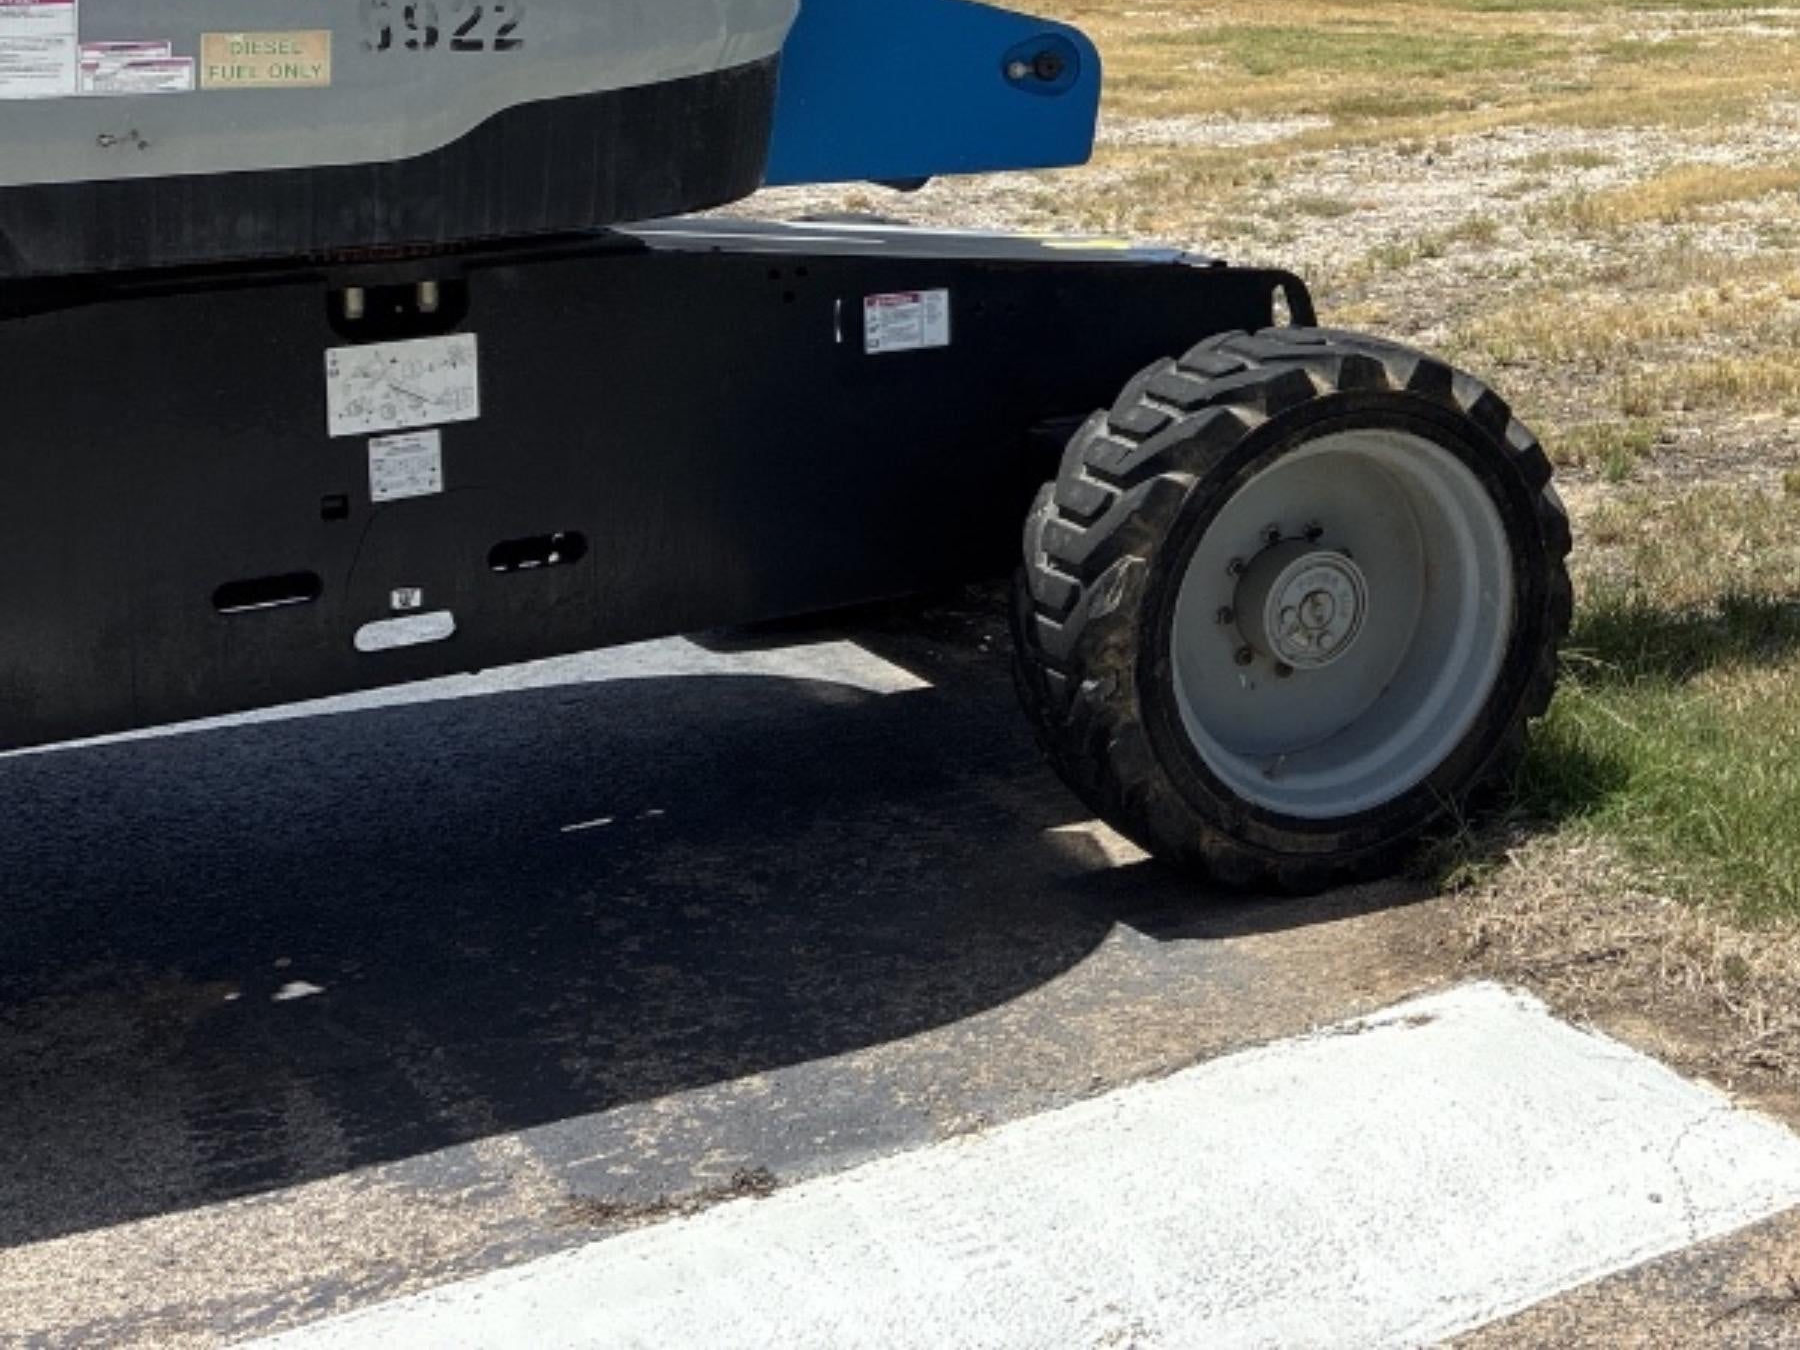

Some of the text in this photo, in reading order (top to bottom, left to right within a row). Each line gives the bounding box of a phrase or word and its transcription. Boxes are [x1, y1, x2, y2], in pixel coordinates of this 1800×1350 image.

[230, 40, 304, 55] DIESEL
[208, 63, 322, 79] FUEL ONLY
